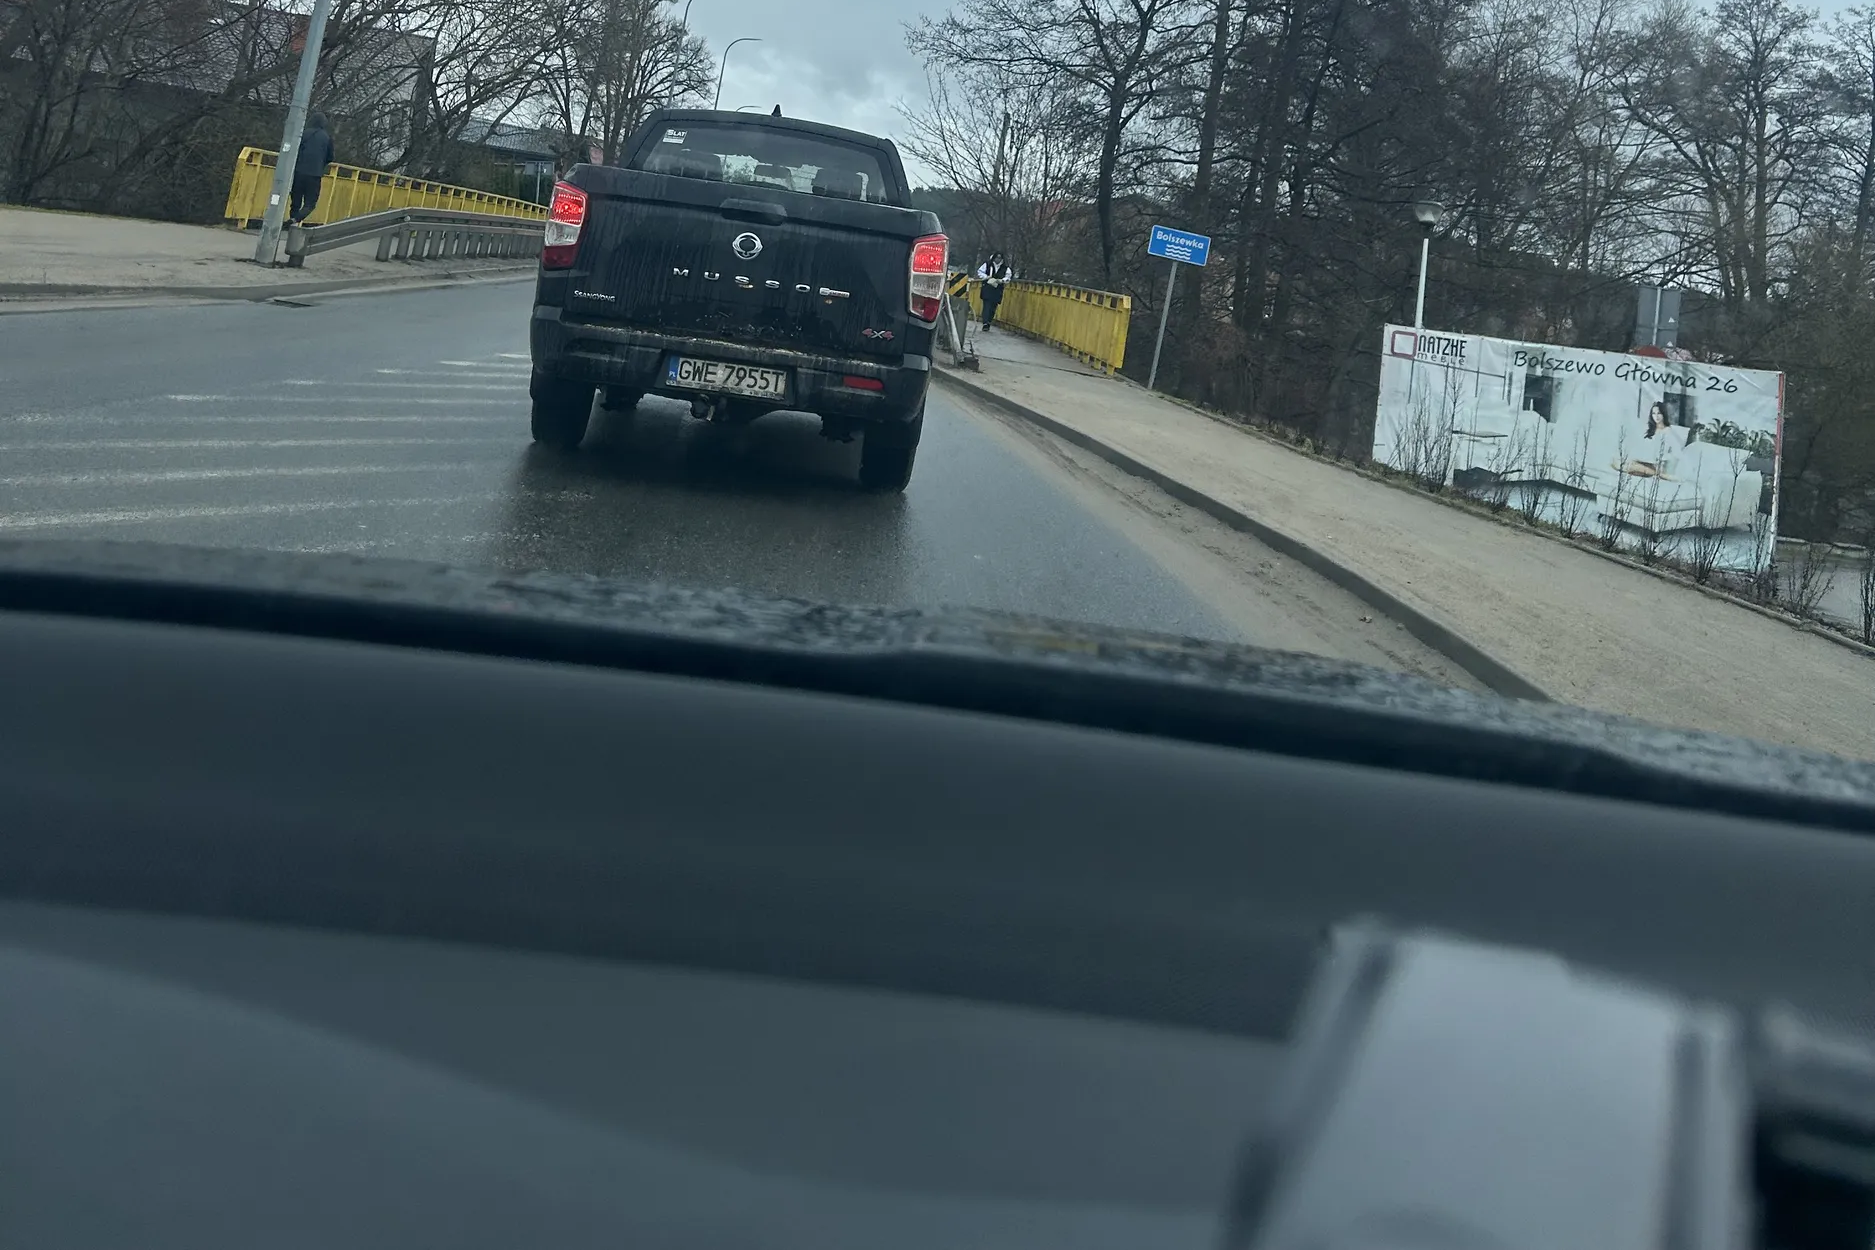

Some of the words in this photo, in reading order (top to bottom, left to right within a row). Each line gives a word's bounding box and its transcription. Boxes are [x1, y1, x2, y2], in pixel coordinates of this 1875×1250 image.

[1156, 231, 1204, 249] Bolszewka
[673, 267, 811, 293] MUSSO
[679, 360, 718, 384] GWE
[722, 365, 784, 392] 7955T
[1514, 351, 1605, 375] Bolszewo
[1615, 362, 1697, 389] Główna
[1706, 376, 1738, 393] 26
